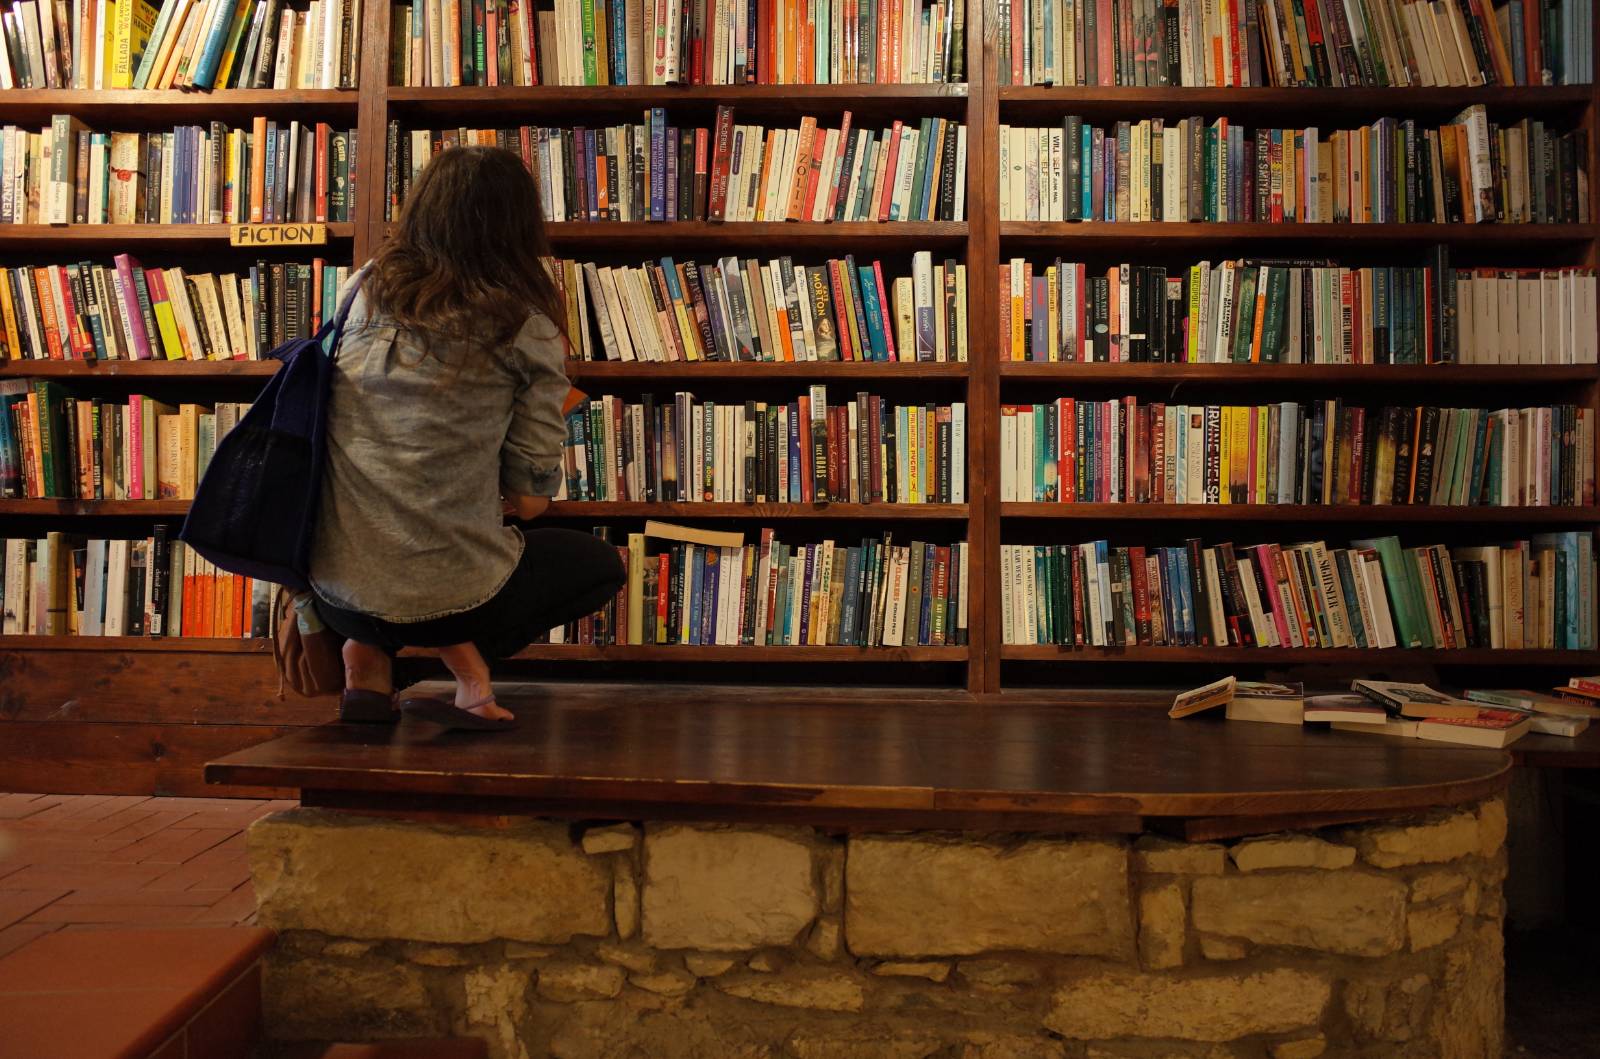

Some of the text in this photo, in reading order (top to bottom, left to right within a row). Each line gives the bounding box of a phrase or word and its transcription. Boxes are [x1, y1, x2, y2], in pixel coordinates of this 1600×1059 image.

[1258, 133, 1267, 161] ZADIE
[3, 168, 12, 217] FRANZEN
[1258, 163, 1268, 195] SMITH
[238, 225, 314, 243] FICTION
[813, 273, 826, 316] MORTON
[1343, 307, 1352, 354] MICHEL TOURNIER
[816, 456, 826, 478] ROADS
[1207, 406, 1219, 504] IRVINE WELSH
[1166, 456, 1174, 491] RELICS
[893, 567, 902, 601] CLOCKERS
[1319, 560, 1338, 608] SIGHTSEER
